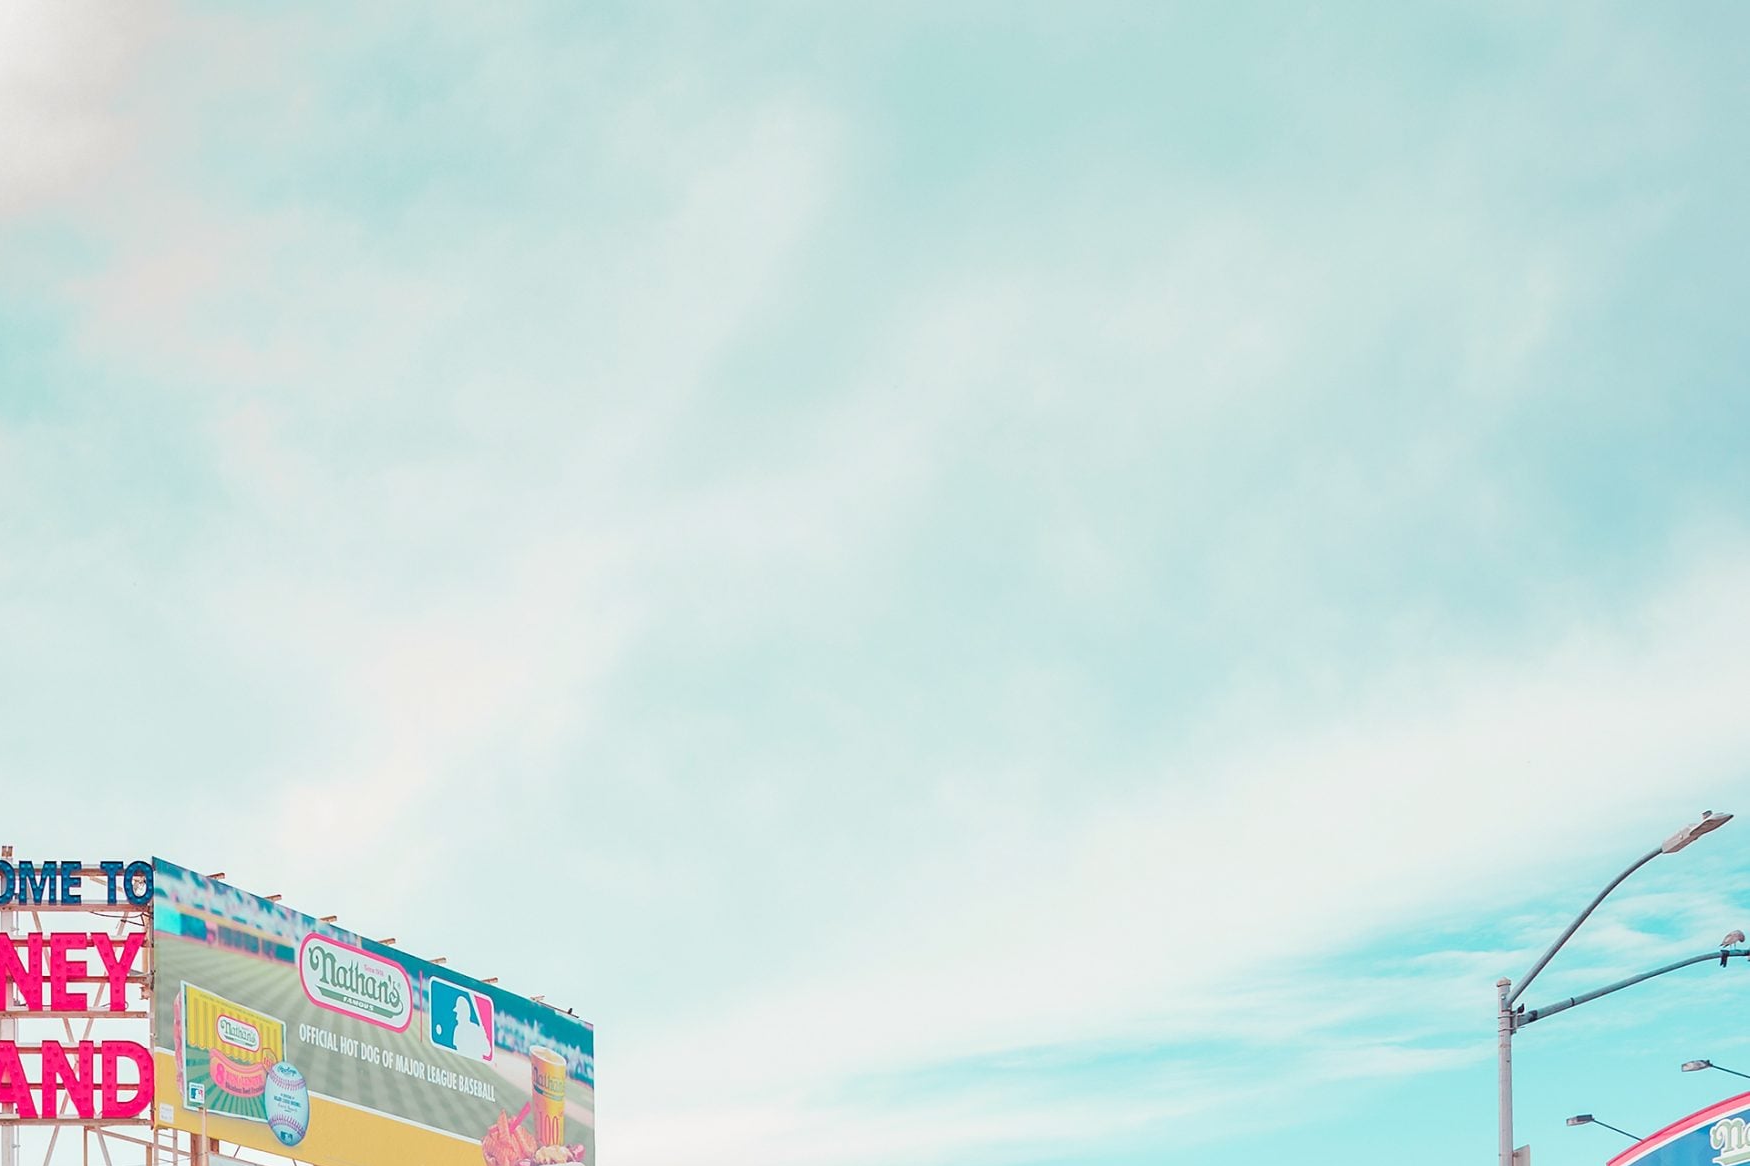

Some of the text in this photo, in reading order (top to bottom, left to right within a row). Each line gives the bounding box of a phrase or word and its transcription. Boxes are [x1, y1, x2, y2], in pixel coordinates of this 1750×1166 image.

[100, 860, 154, 905] TO
[308, 945, 401, 1008] Nathan's
[343, 996, 375, 1012] FAMOUS
[299, 1023, 496, 1102] OFFICIAL HOT DOG OF MAJOR LEAGUE BASEBALL
